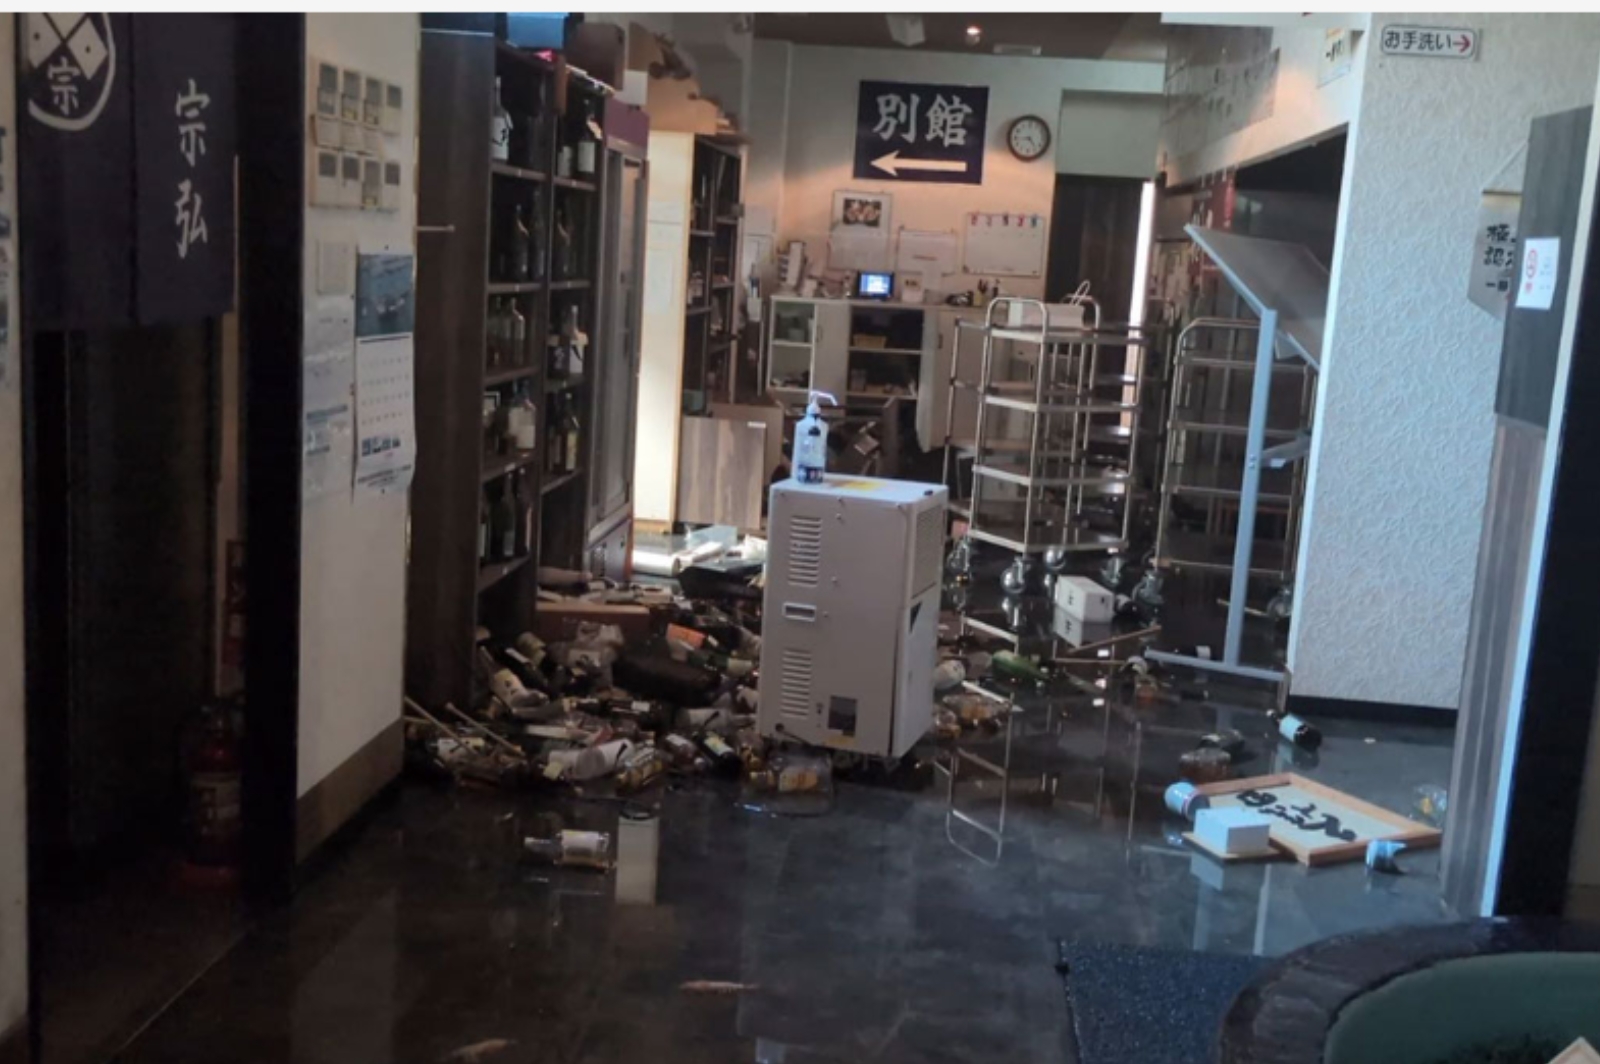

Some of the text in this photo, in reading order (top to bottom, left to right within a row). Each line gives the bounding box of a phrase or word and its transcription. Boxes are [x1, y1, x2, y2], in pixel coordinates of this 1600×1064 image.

[1384, 30, 1452, 51] お手洗い
[48, 55, 80, 117] 宗
[872, 93, 973, 148] 別館
[174, 78, 211, 259] 宗弘
